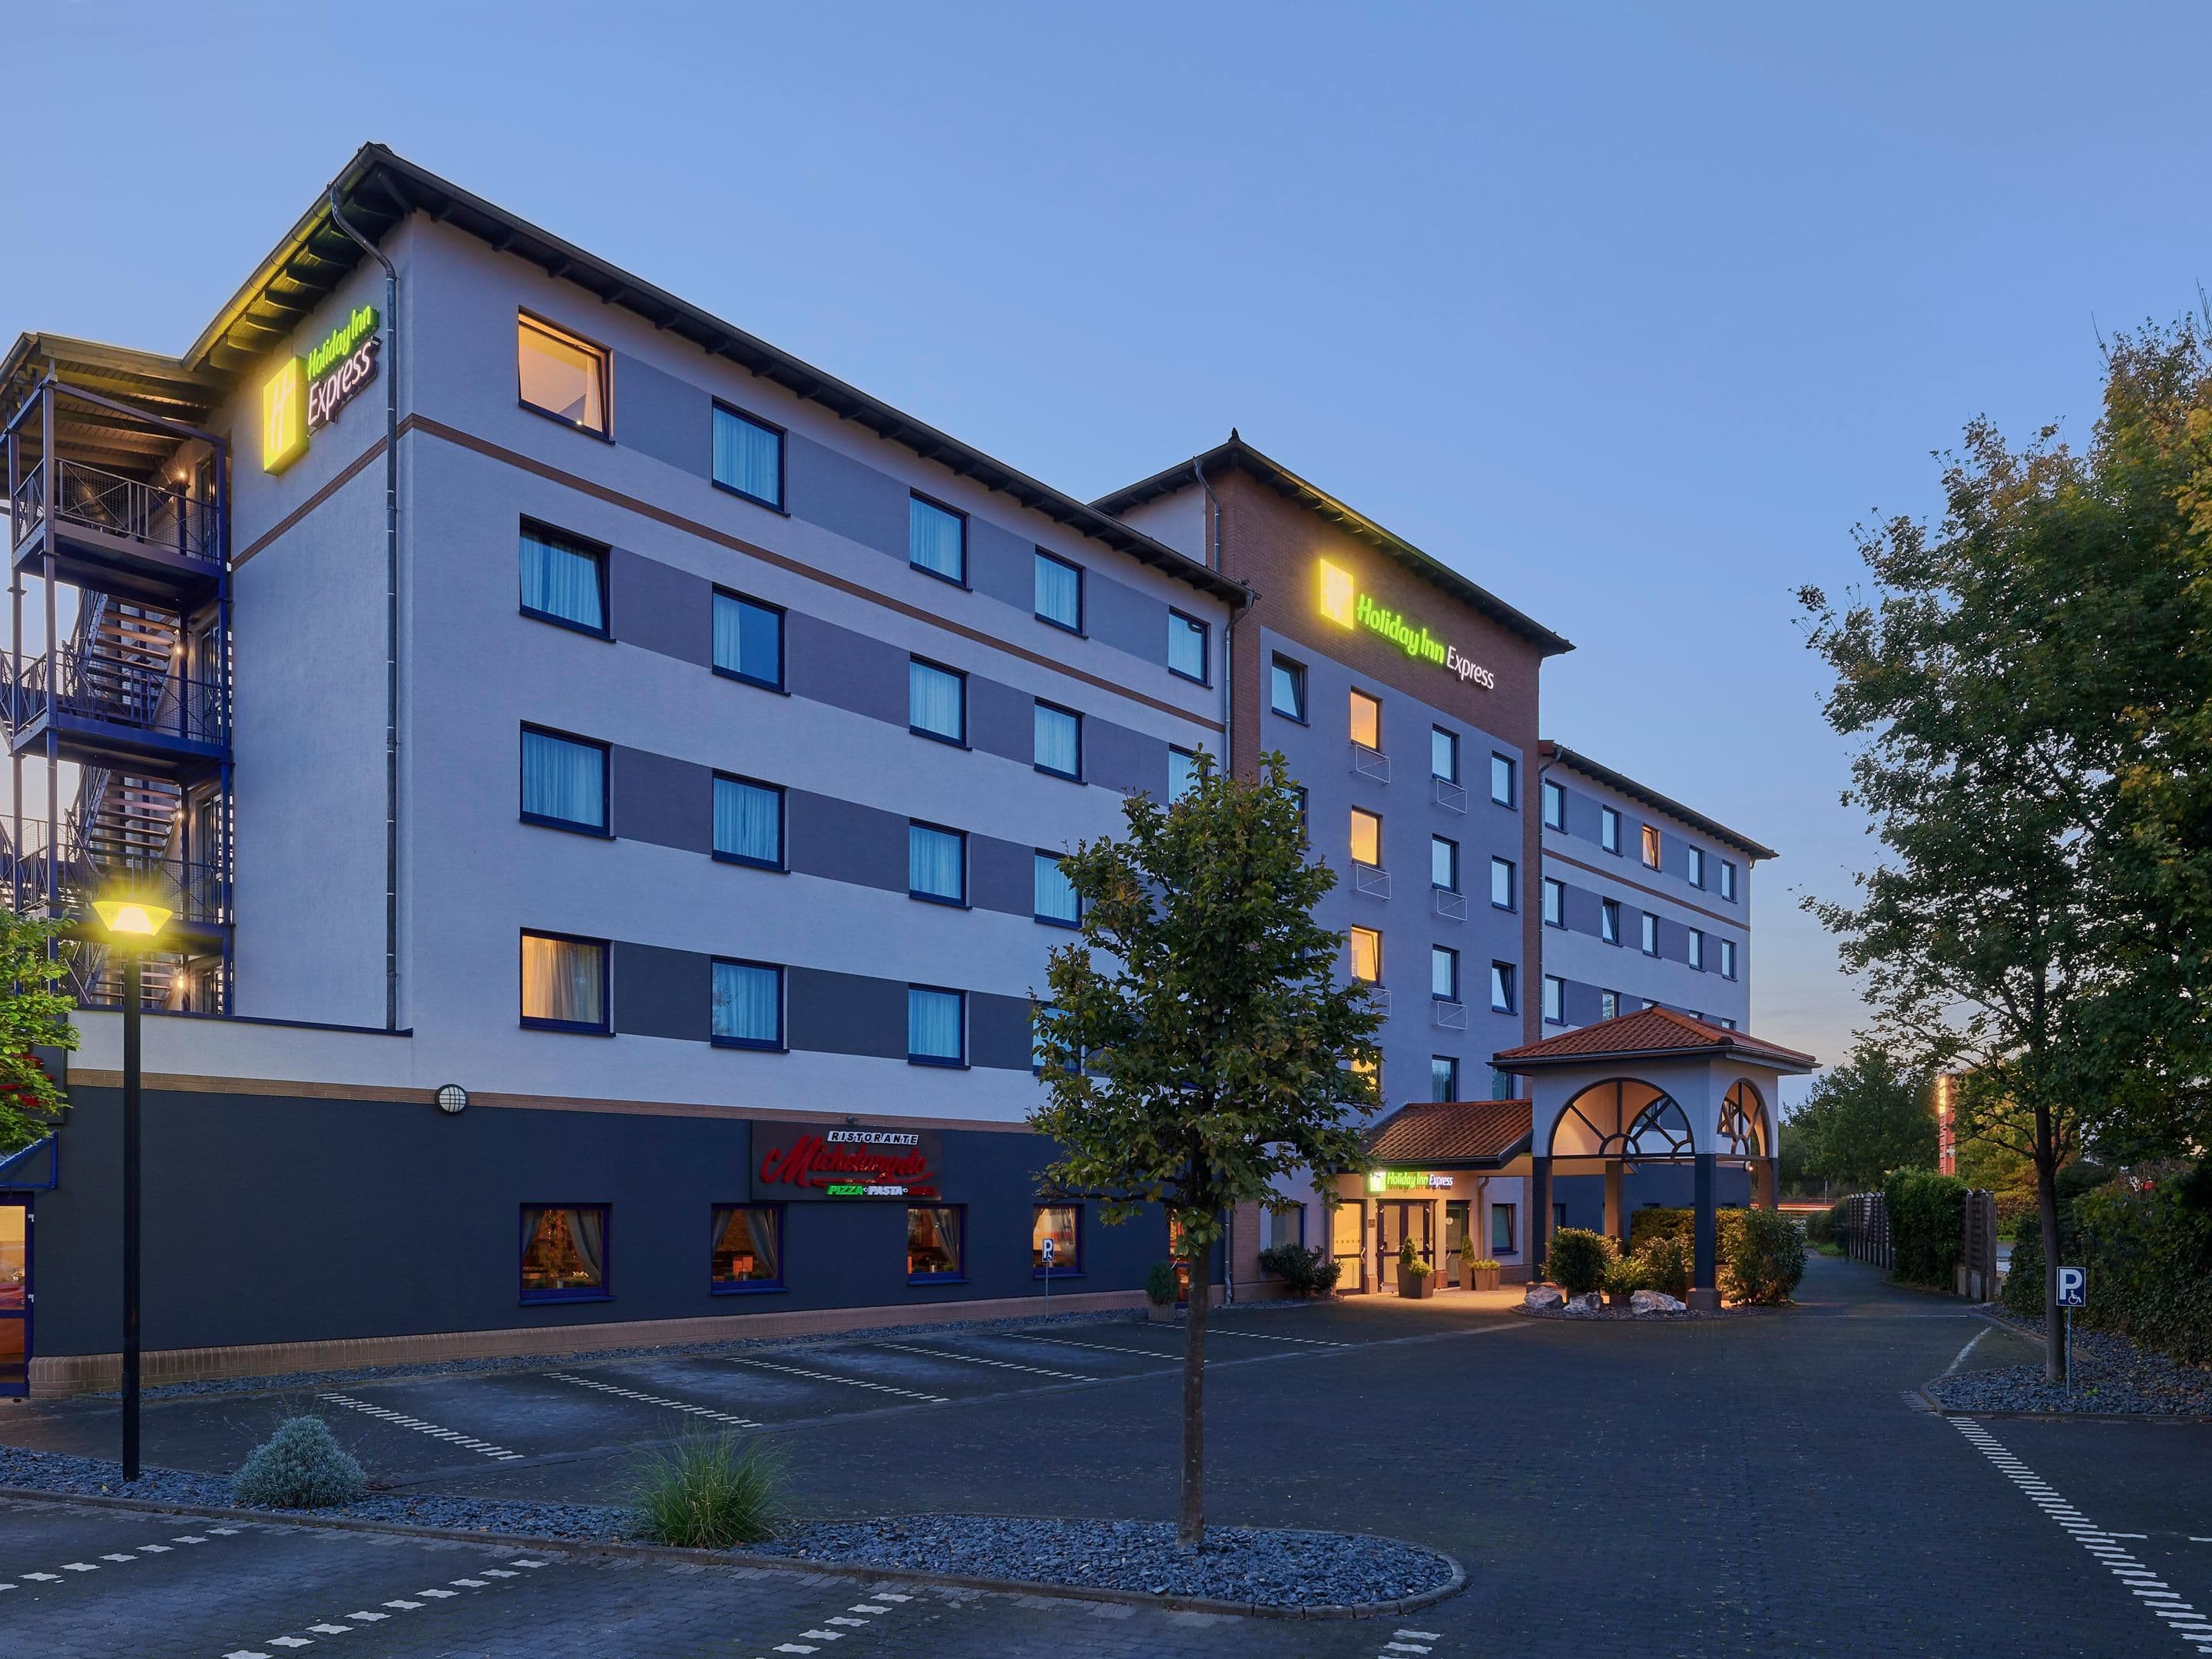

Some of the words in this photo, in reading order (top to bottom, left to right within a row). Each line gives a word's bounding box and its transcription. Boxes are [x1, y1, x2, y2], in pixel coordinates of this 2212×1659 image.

[308, 329, 351, 380] Holiday
[351, 306, 372, 339] Inn
[308, 342, 372, 426] Express
[1357, 594, 1420, 656] Holiday
[1420, 628, 1445, 665] Inn
[1446, 645, 1495, 690] Express
[830, 1131, 919, 1144] RISTORANTE
[826, 1185, 864, 1195] PIZZA
[867, 1185, 903, 1195] PASTA
[1386, 1171, 1416, 1188] Holiday
[1416, 1171, 1429, 1186] Inn
[1429, 1174, 1453, 1188] Express
[1043, 1239, 1053, 1259] P
[2059, 1269, 2083, 1300] P
